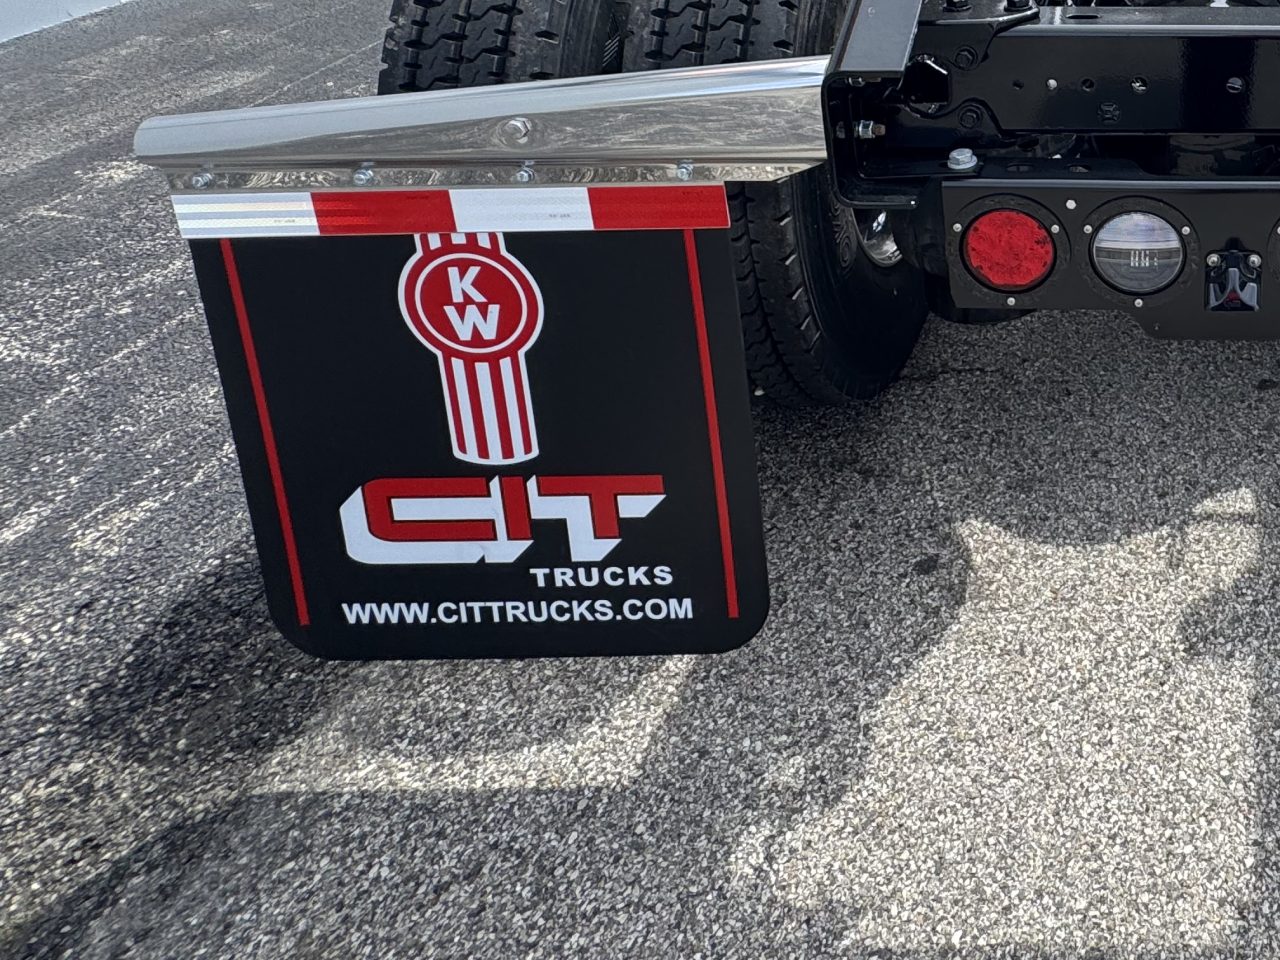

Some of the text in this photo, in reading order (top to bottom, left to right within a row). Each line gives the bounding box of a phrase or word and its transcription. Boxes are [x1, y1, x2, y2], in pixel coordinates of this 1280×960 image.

[339, 474, 667, 564] CIT
[529, 566, 673, 587] TRUCKS
[341, 599, 694, 625] WWW.CITTRUCKS.COM
